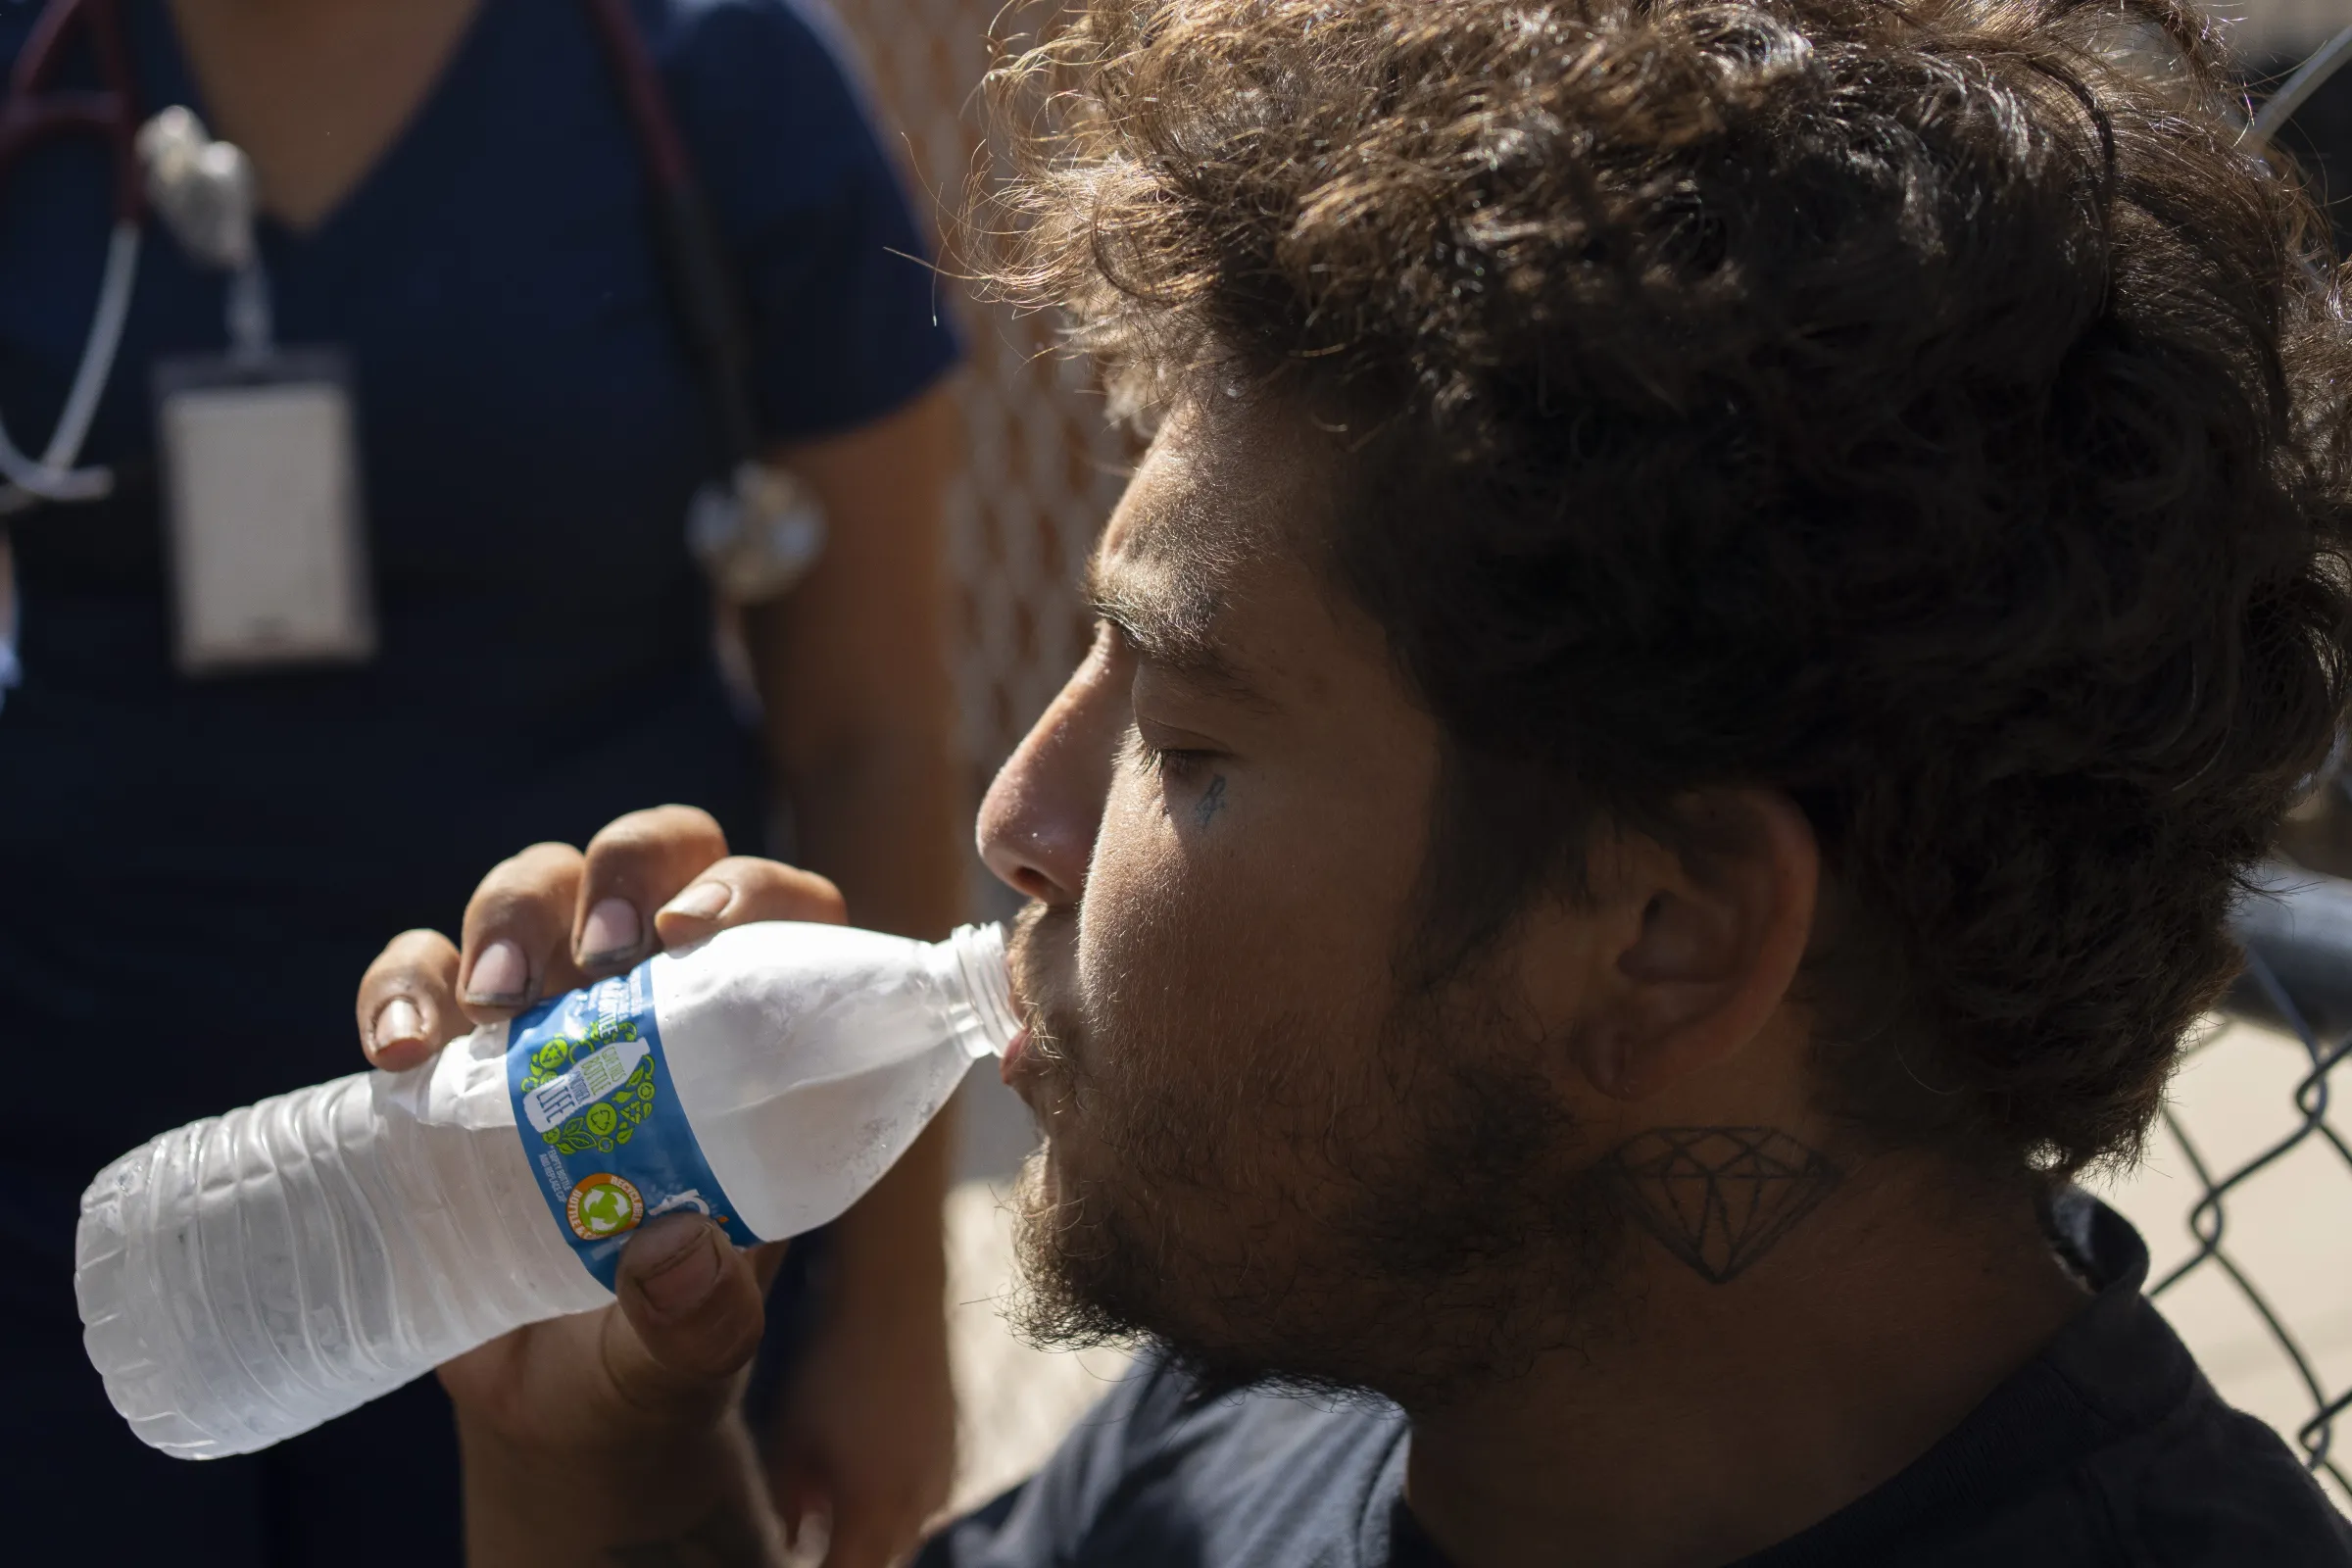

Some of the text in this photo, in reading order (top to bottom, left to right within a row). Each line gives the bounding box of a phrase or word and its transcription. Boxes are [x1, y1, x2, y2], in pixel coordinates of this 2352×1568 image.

[566, 1070, 591, 1104] ANOTHER
[580, 1055, 611, 1096] BOTTLE
[536, 1079, 575, 1123] LIFE
[539, 1153, 550, 1166] AND
[544, 1166, 562, 1192] REPLACE
[556, 1167, 572, 1190] BOTTLE
[567, 1188, 583, 1230] BOTTLE
[611, 1175, 644, 1223] RECYCLABLE
